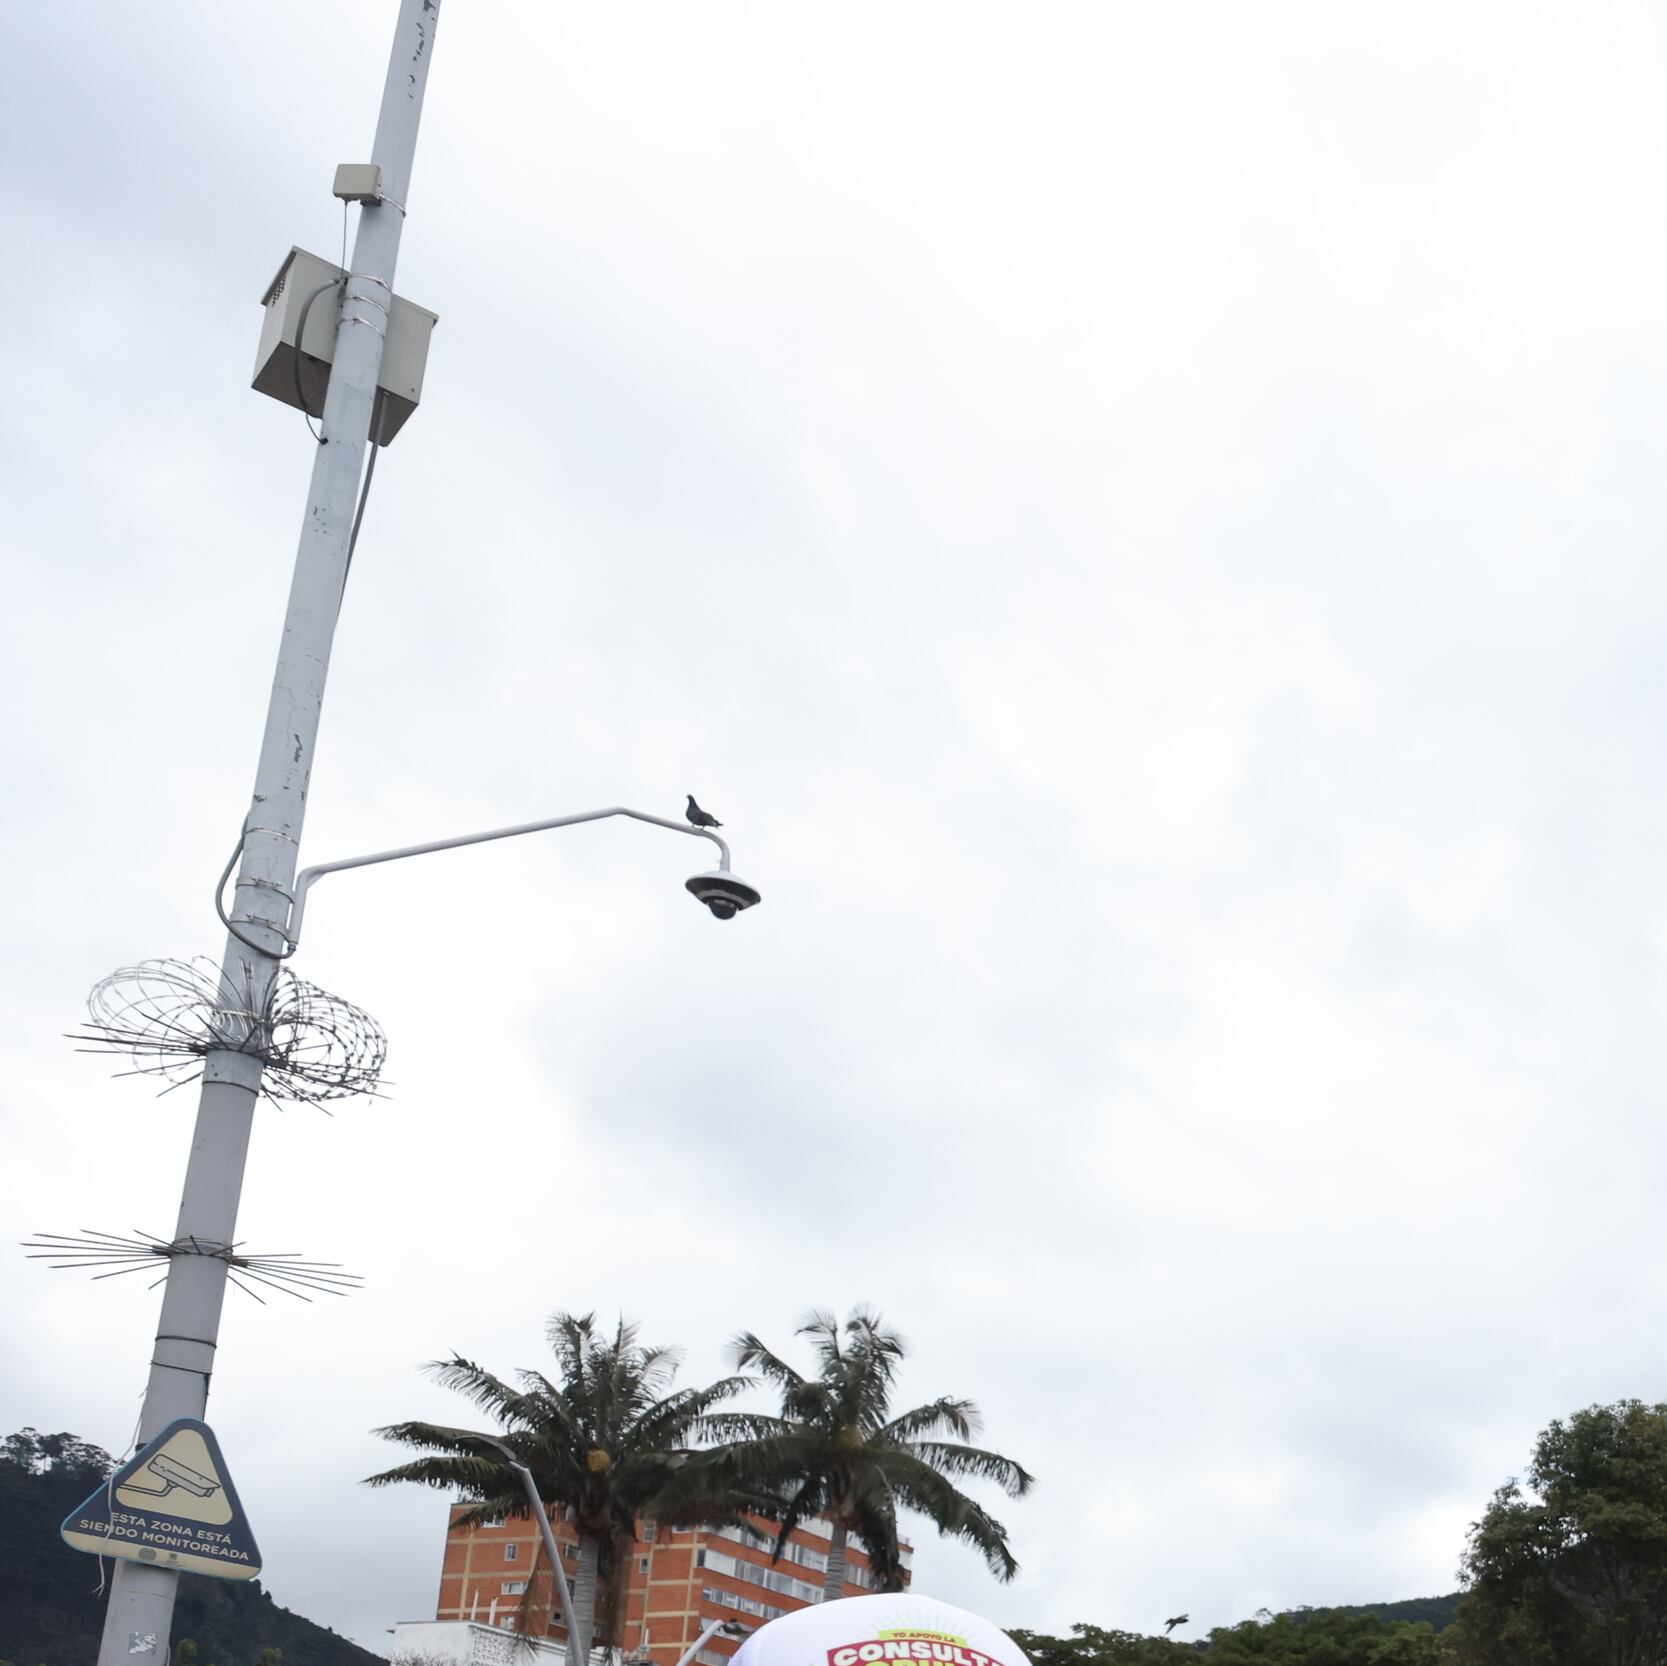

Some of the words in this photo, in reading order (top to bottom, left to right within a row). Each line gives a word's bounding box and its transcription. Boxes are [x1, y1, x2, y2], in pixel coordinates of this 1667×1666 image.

[79, 1519, 138, 1538] SIENDO
[142, 1532, 249, 1561] MONITOREADA
[111, 1512, 146, 1527] ESTA
[151, 1520, 193, 1537] ZONA
[197, 1530, 232, 1544] ESTÁ
